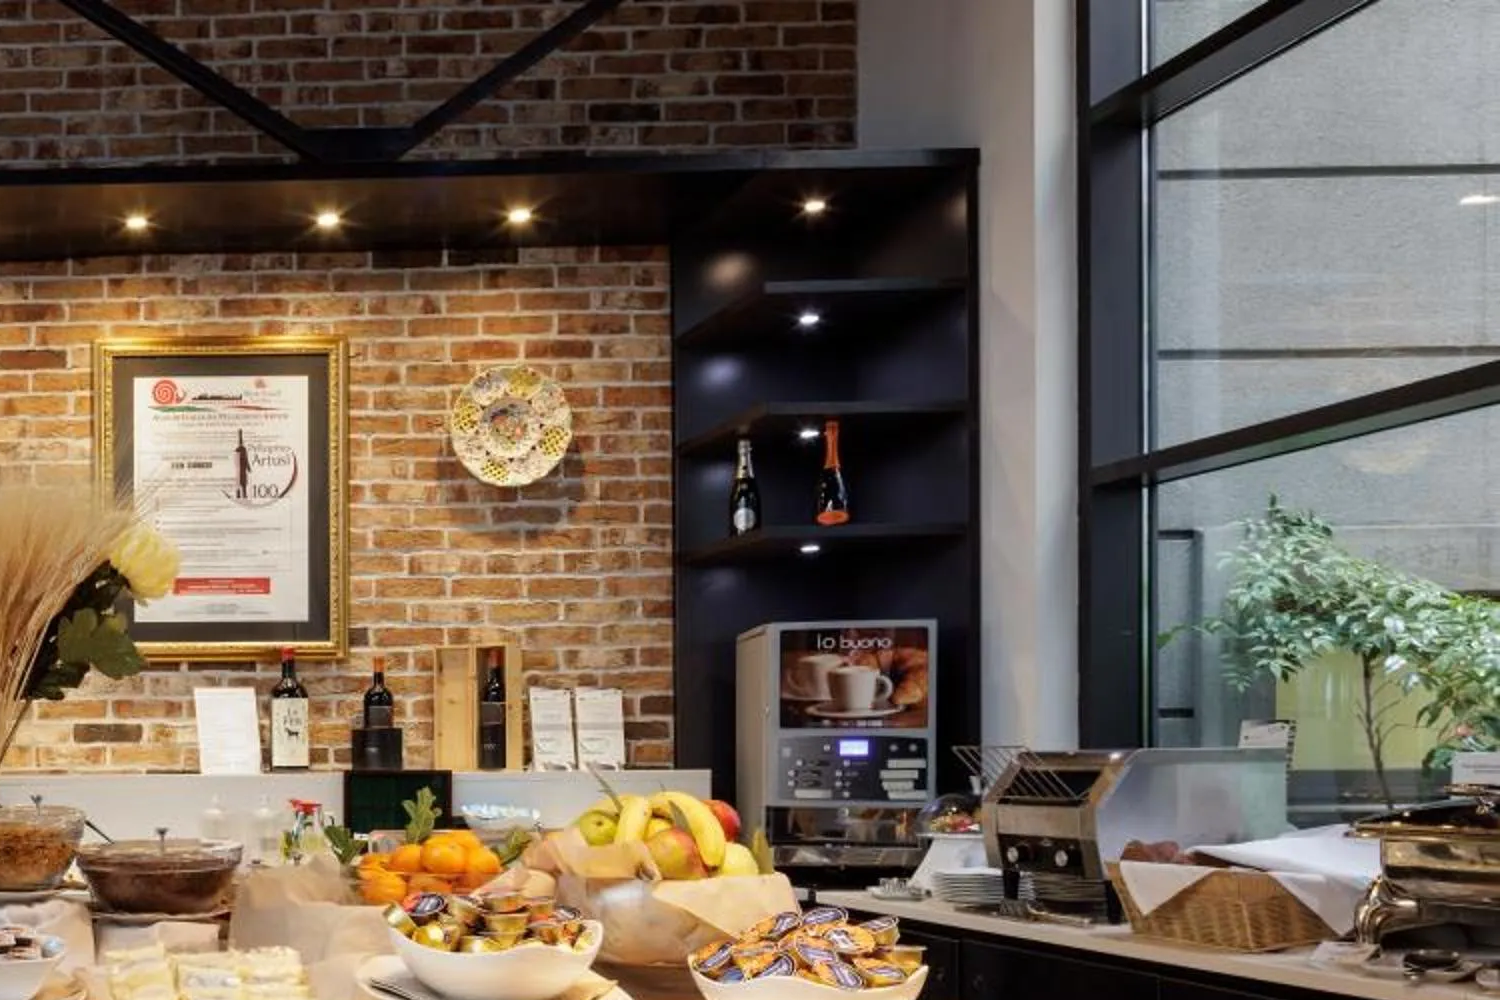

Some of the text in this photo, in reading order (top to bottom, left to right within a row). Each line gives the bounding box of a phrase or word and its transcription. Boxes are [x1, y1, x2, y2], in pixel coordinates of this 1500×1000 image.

[251, 453, 291, 466] Artusi
[253, 483, 279, 499] 100
[817, 633, 893, 650] lo buono
